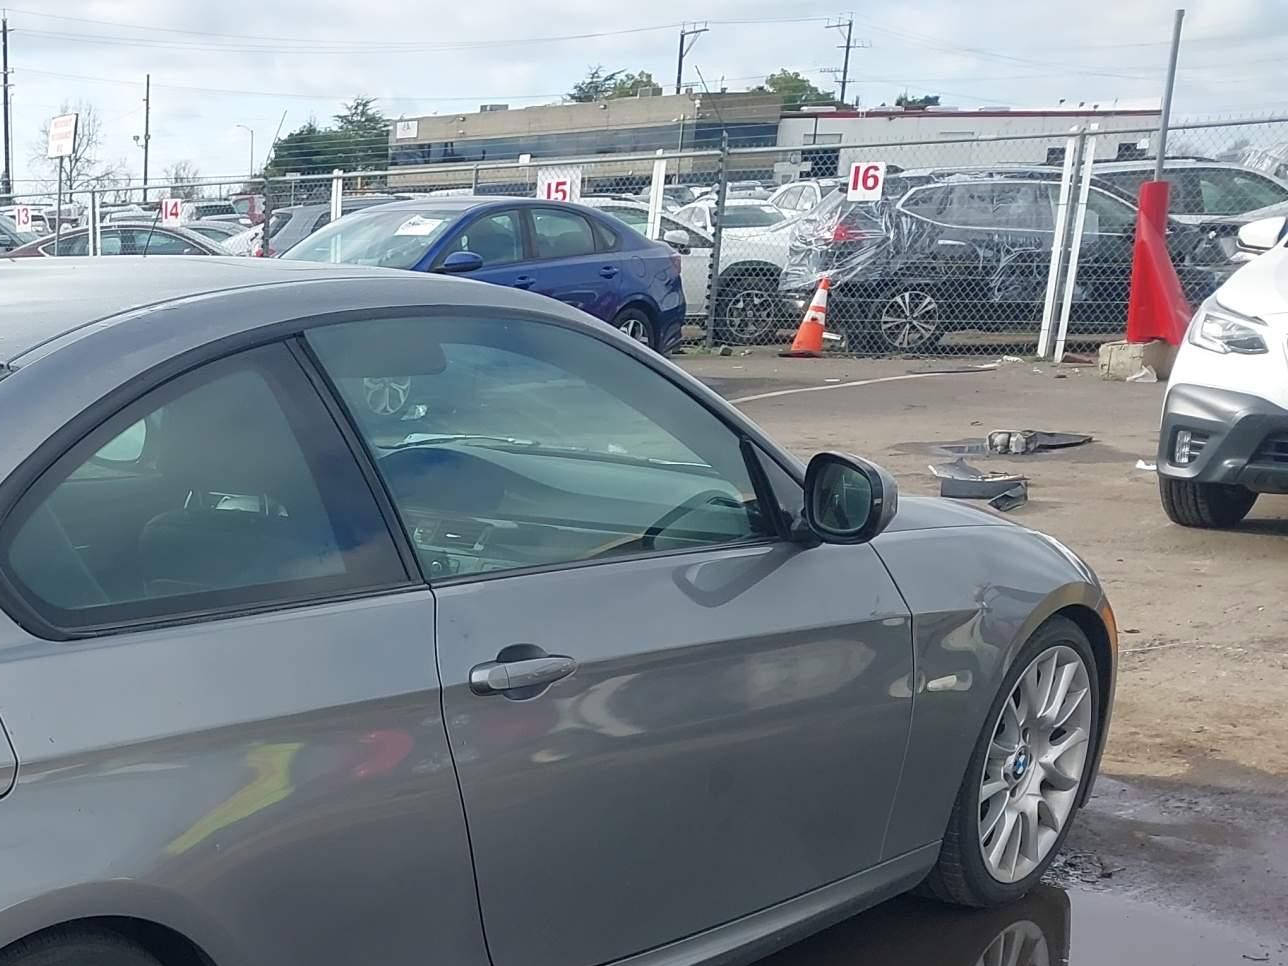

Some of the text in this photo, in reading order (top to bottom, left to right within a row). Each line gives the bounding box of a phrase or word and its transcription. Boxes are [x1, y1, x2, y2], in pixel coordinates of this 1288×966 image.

[852, 165, 880, 191] 16
[546, 181, 567, 201] 15
[17, 207, 30, 225] 13
[164, 201, 179, 219] 14
